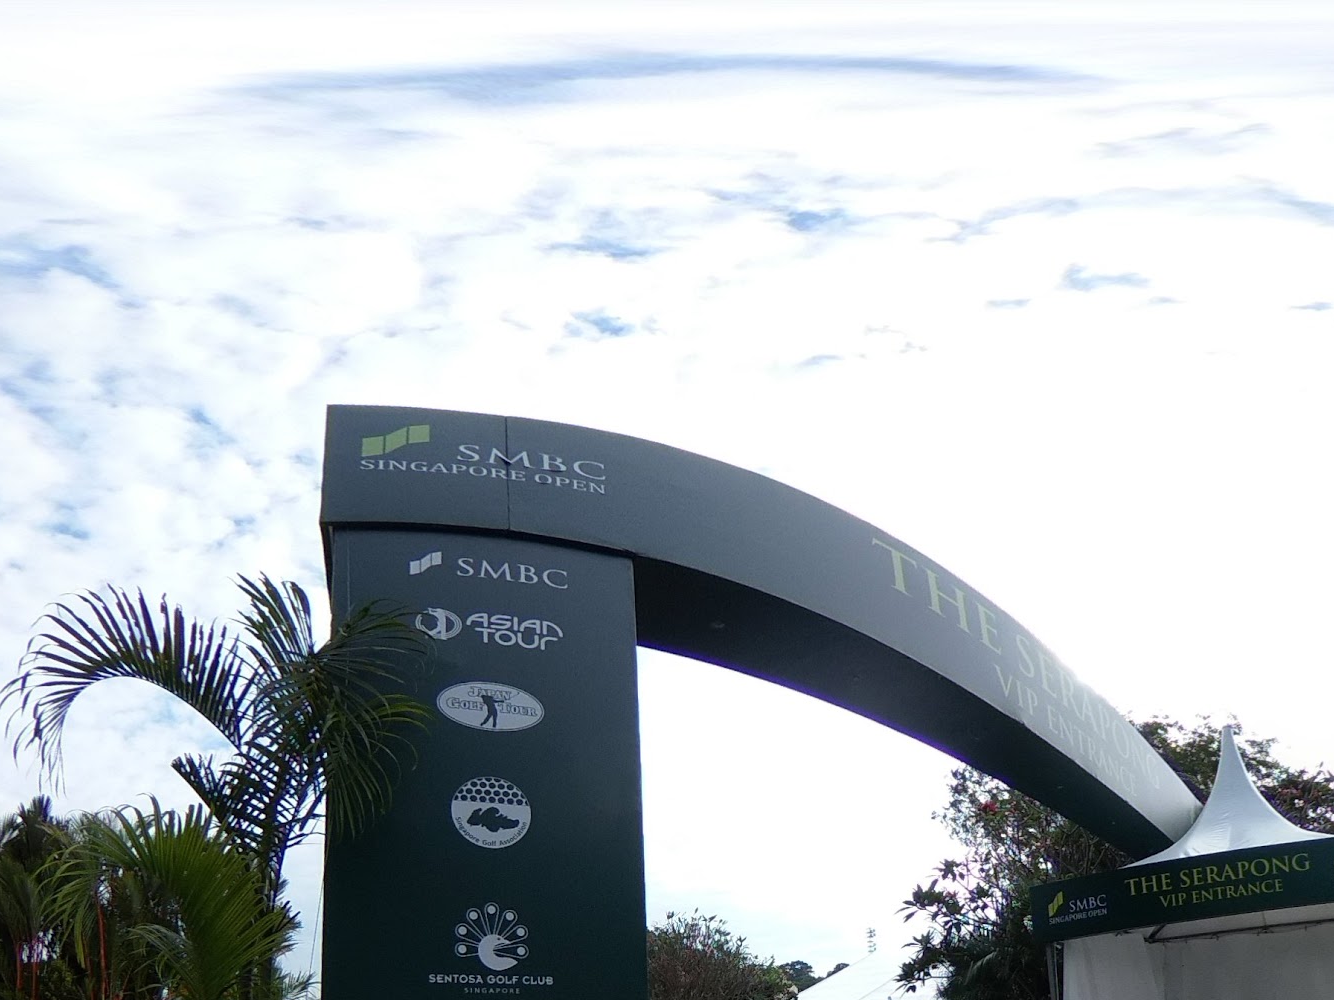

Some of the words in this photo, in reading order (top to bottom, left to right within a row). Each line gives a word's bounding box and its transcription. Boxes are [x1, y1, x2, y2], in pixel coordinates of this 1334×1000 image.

[360, 459, 526, 482] SINGAPORE
[535, 473, 606, 495] OPEN
[457, 444, 607, 481] SMBC
[457, 558, 568, 589] SMBC
[466, 612, 564, 638] ASIAN
[474, 627, 558, 650] TOUR
[872, 537, 1001, 655] THE
[1016, 634, 1160, 789] SERAPONG
[994, 664, 1038, 715] VIP
[1047, 705, 1138, 797] ENTRANCE
[455, 816, 480, 844] Singapore
[482, 839, 496, 847] Golf
[499, 821, 528, 847] Association
[1124, 873, 1173, 896] THE
[1179, 853, 1311, 888] SERAPONG
[1069, 894, 1107, 912] SMBC
[1159, 892, 1187, 908] VIP
[1192, 879, 1283, 903] ENTRANCE
[1049, 912, 1087, 925] SINGAPORE
[1088, 908, 1107, 917] OPEN
[428, 973, 484, 984] SENTOSA
[487, 975, 519, 985] GOLF
[522, 976, 554, 985] CLUB
